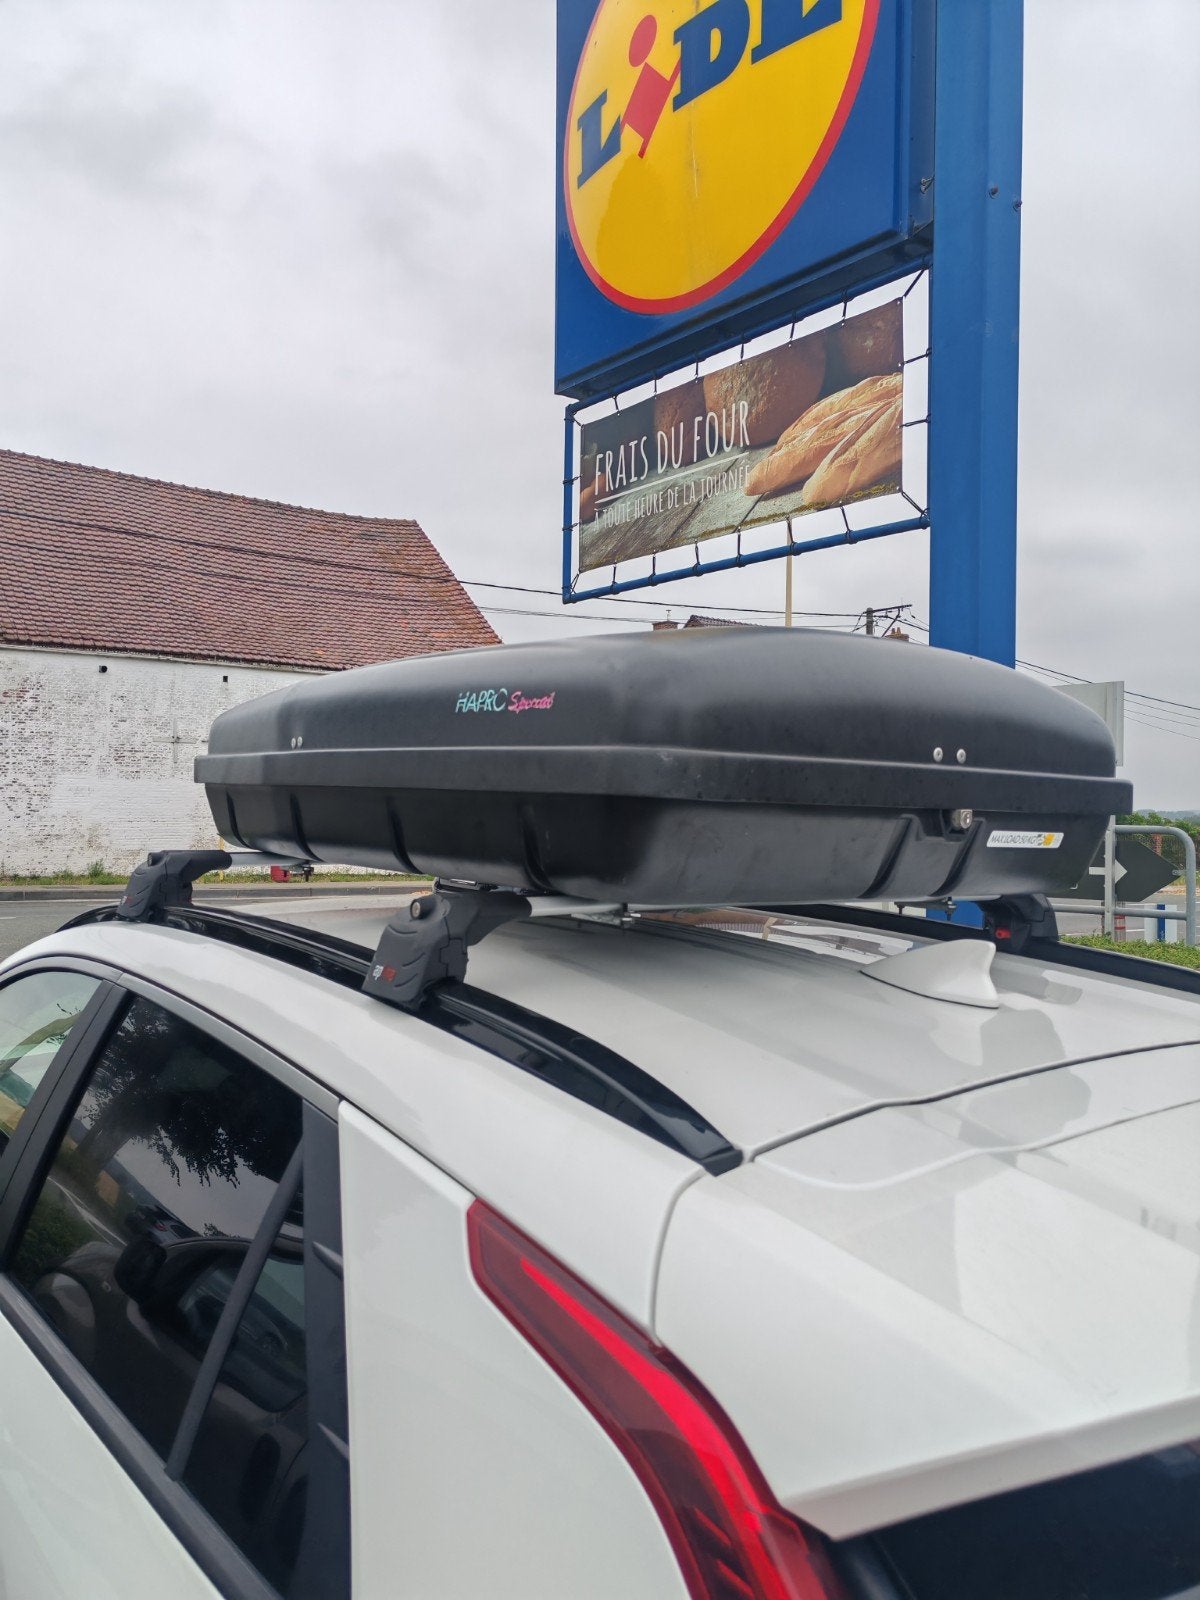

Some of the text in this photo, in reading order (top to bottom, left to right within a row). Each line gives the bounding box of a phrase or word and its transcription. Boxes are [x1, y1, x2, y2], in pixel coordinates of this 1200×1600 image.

[594, 400, 750, 496] FRAIS DU FOUR
[602, 500, 631, 529] TOUTE
[634, 494, 664, 519] HEURE
[667, 486, 679, 509] DE
[683, 481, 697, 506] LA
